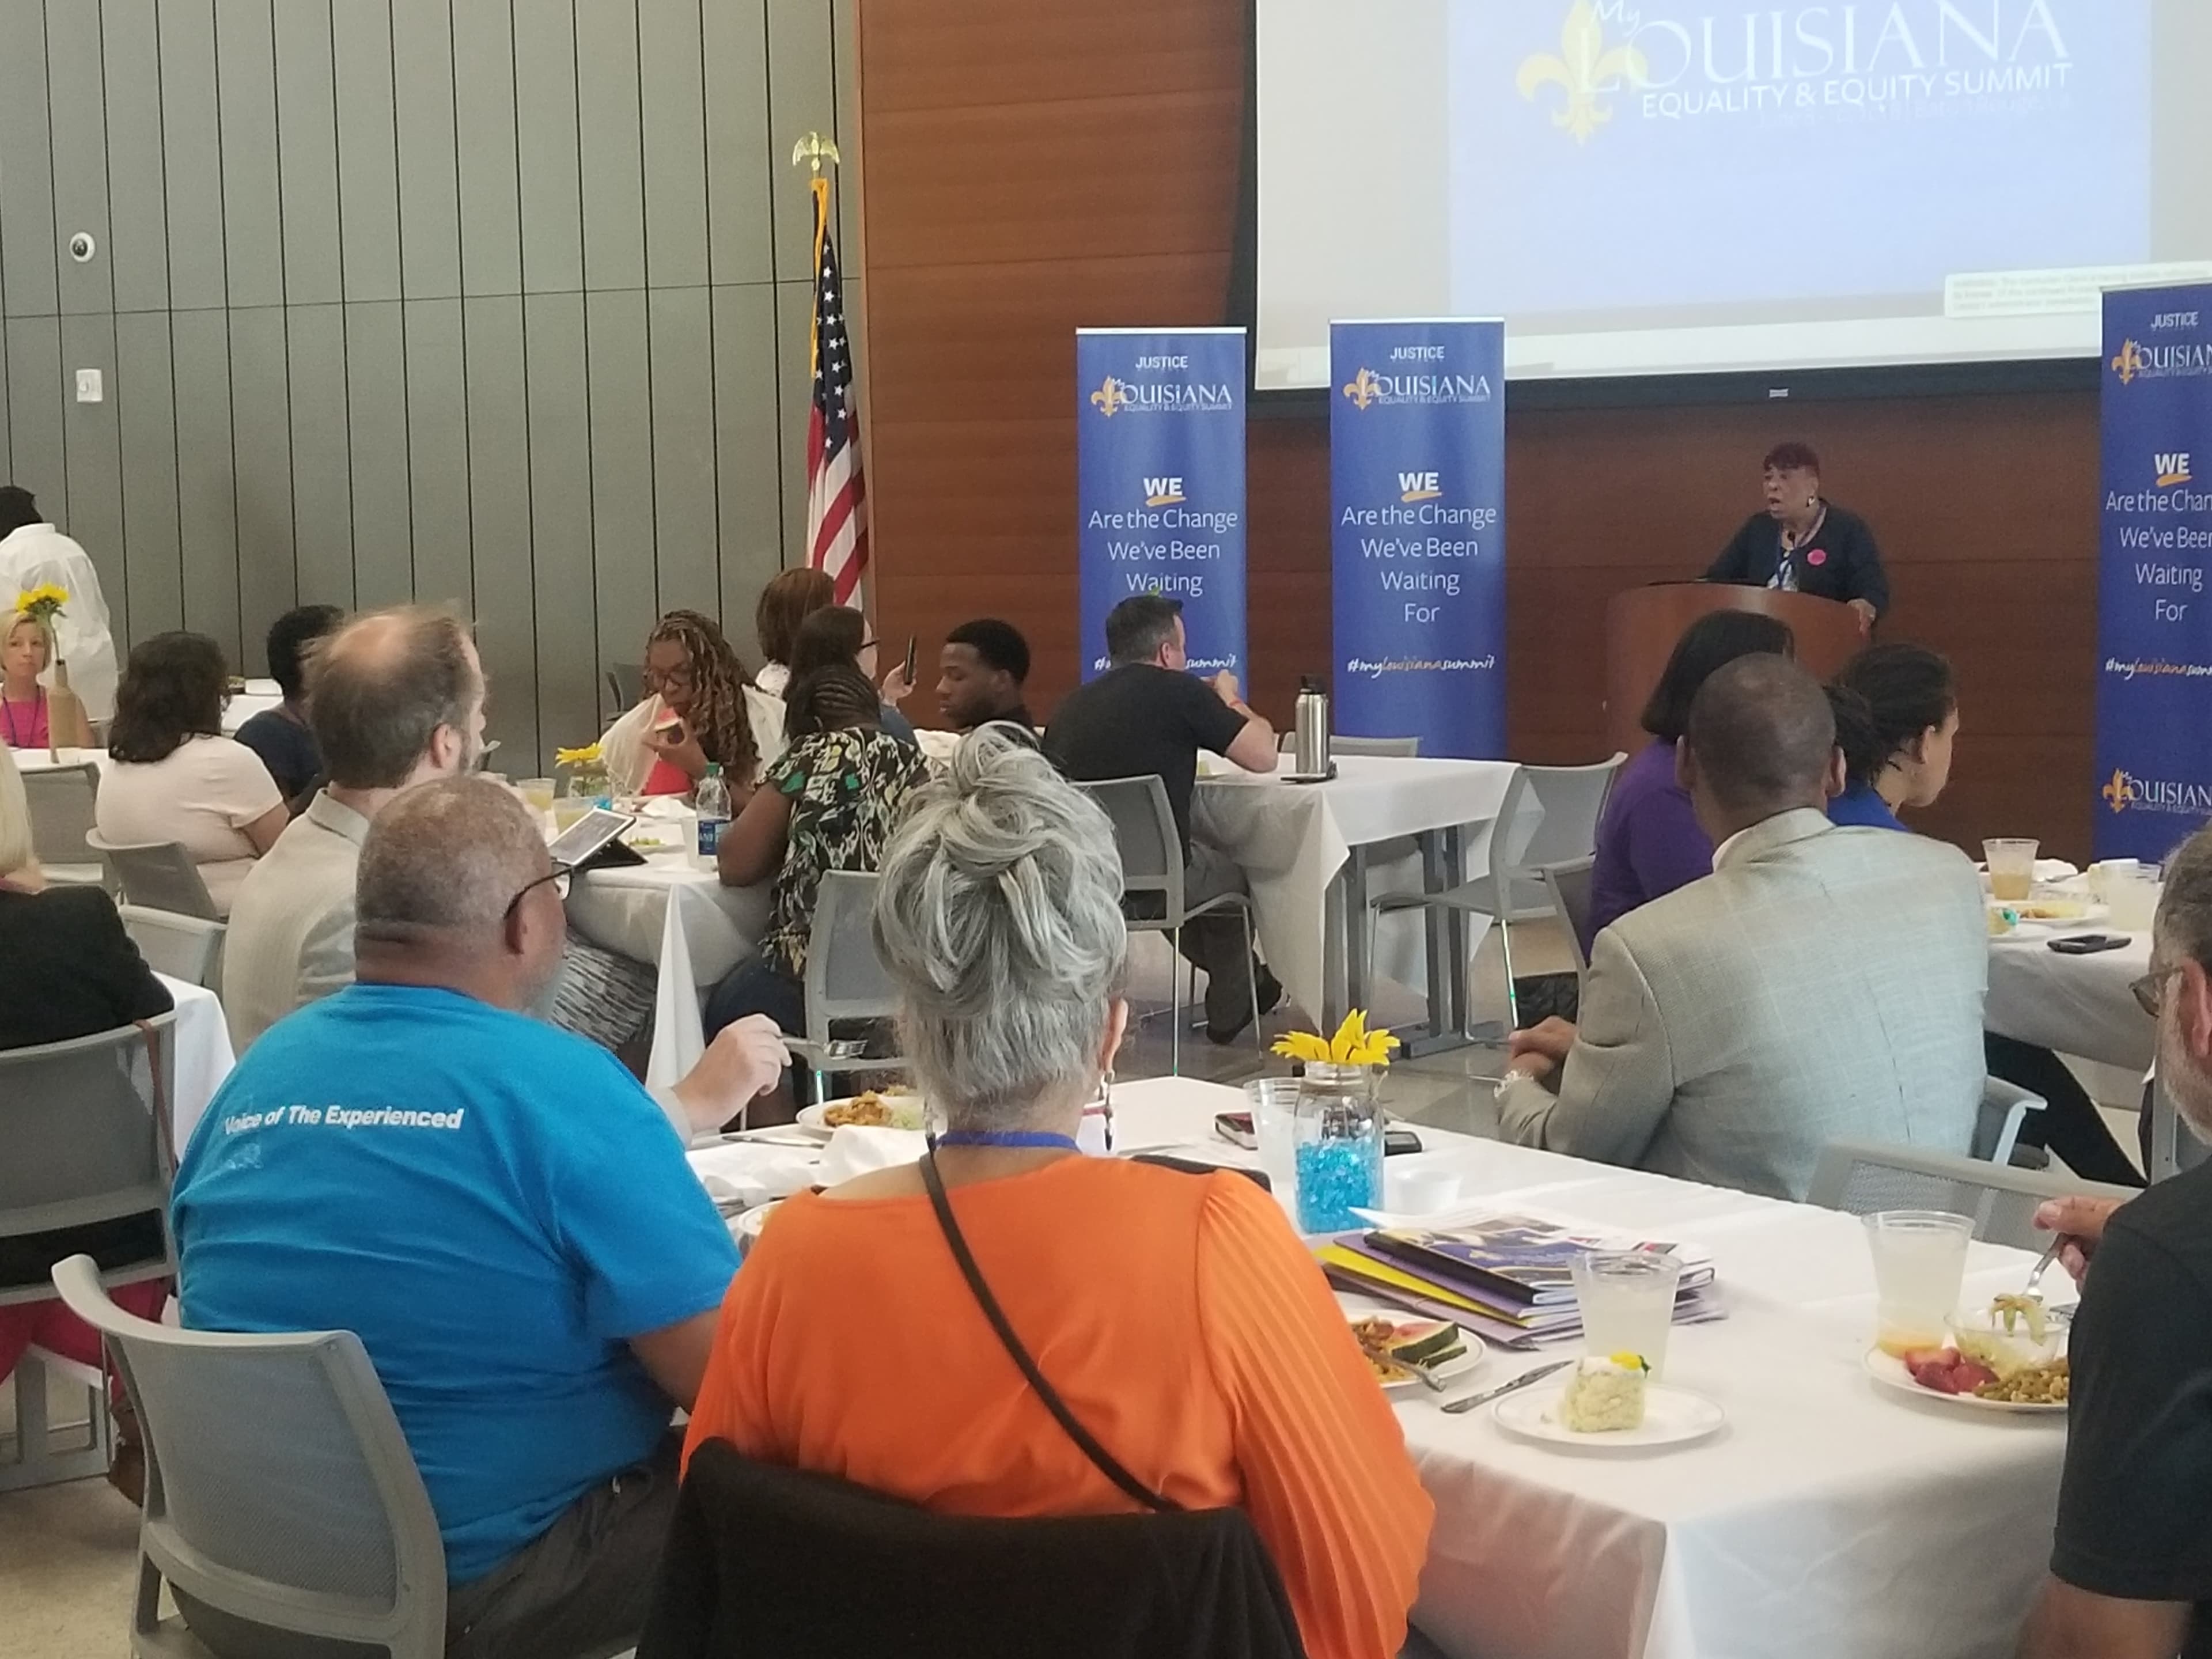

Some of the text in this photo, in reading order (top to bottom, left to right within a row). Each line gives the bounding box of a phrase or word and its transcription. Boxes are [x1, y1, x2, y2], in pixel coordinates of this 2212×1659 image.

[1643, 84, 1790, 119] EQUALITY
[1795, 82, 1817, 107] &
[1824, 73, 1936, 105] EQUITY
[1945, 62, 2073, 97] SUMMIT
[2151, 312, 2199, 328] JUSTICE
[1135, 355, 1188, 369] JUSTICE
[1390, 346, 1445, 361] JUSTICE
[2154, 453, 2190, 474] WE
[1143, 478, 1183, 497] WE
[1399, 472, 1439, 491] WE
[2106, 490, 2134, 512] Are
[2138, 489, 2169, 512] the
[1088, 508, 1238, 533] Are the Change
[1342, 504, 1497, 530] Are the Change
[1361, 537, 1478, 558] We've Been
[2120, 527, 2173, 548] We've
[1108, 540, 1220, 560] We've Been
[1126, 573, 1203, 597] Waiting
[1381, 570, 1460, 596] Waiting
[2135, 563, 2203, 592] Waiting
[1404, 604, 1440, 623] For
[2156, 599, 2188, 621] For
[1348, 654, 1496, 679] #mylouisianasummit
[225, 1104, 464, 1135] Voice of The Experienced
